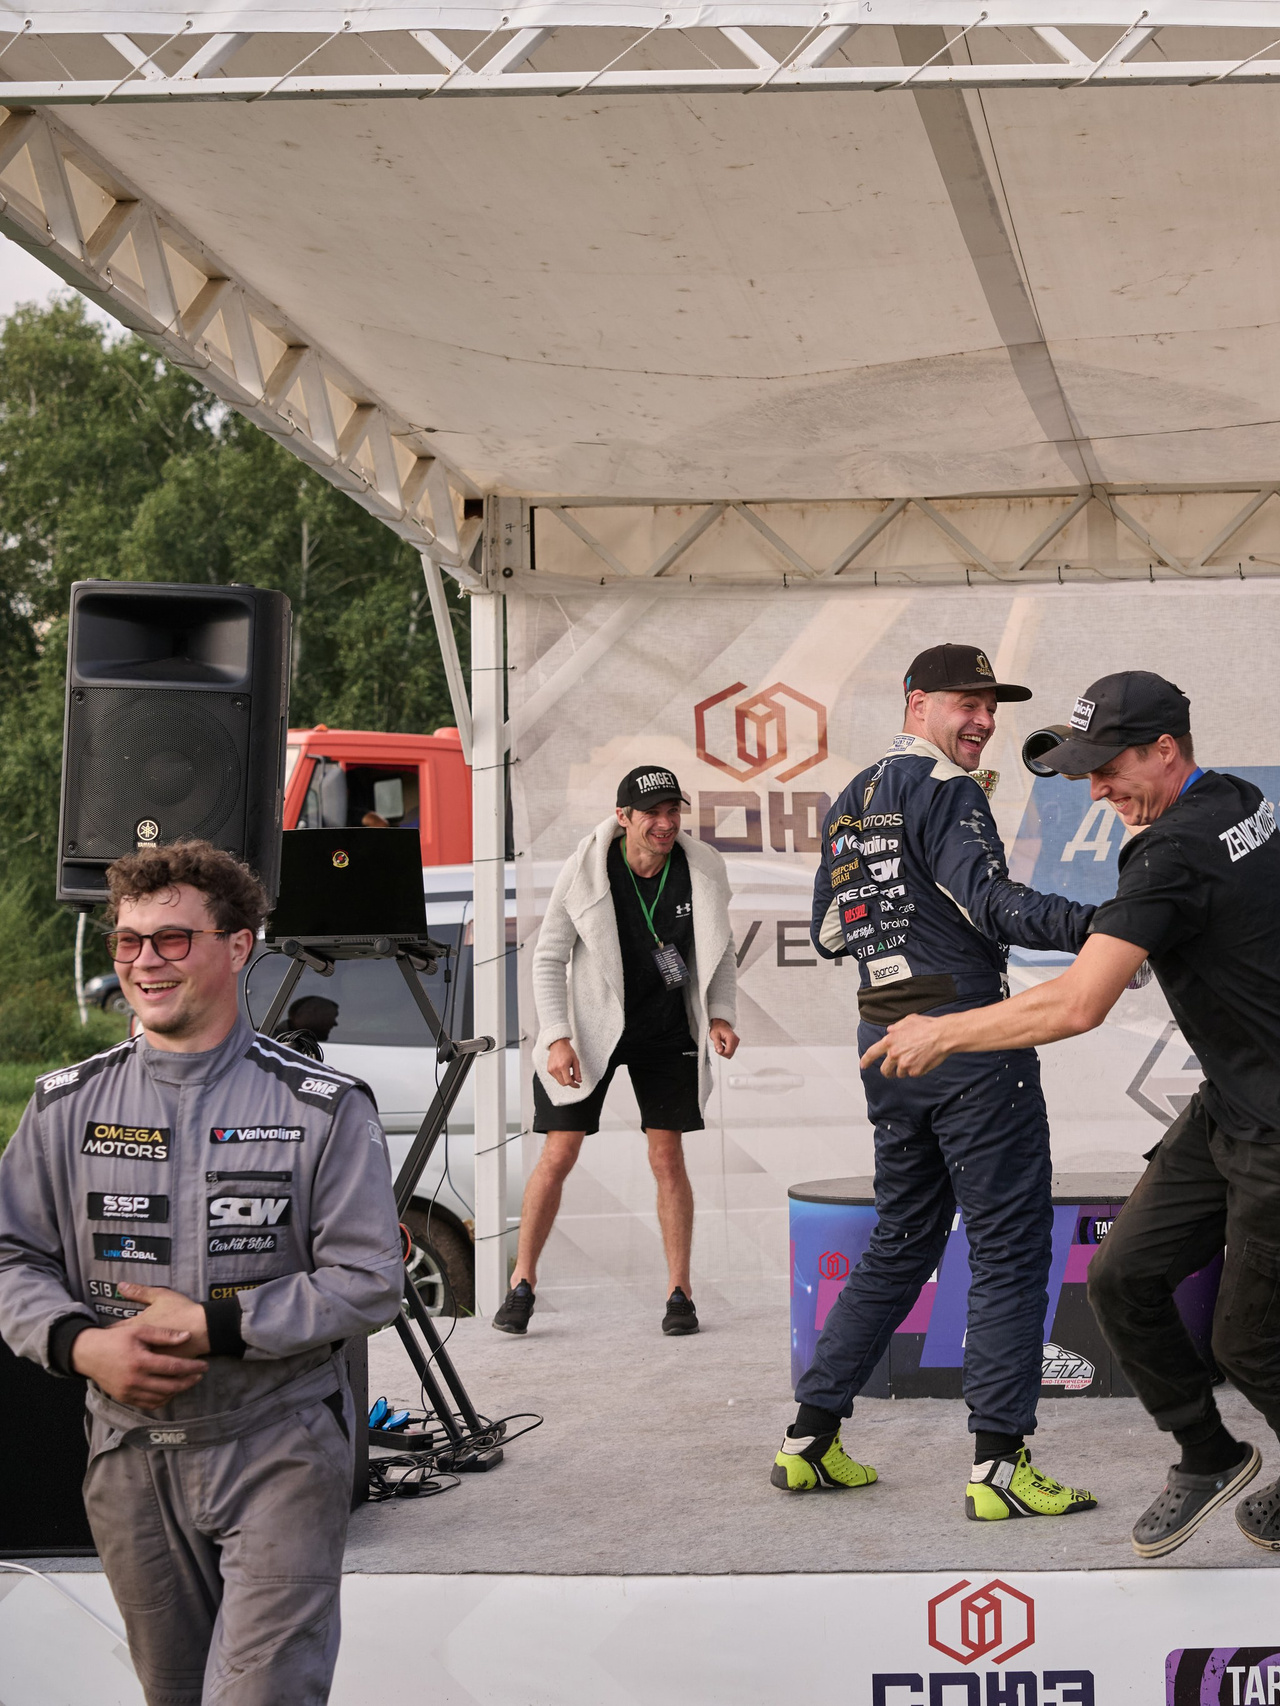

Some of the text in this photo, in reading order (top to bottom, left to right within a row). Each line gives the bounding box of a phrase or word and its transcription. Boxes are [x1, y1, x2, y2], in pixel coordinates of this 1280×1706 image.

[636, 772, 675, 789] TARGET
[857, 934, 906, 959] SIBALUX
[44, 1071, 79, 1090] OMP
[301, 1080, 338, 1097] OMP
[94, 1125, 163, 1143] OMEGA
[237, 1128, 301, 1141] Valvoline
[83, 1139, 168, 1160] MOTORS
[103, 1195, 150, 1213] SSP
[209, 1197, 290, 1227] SCW
[103, 1249, 157, 1261] LINKGLOBAL
[95, 1304, 144, 1318] RECE
[150, 1433, 187, 1444] OMP
